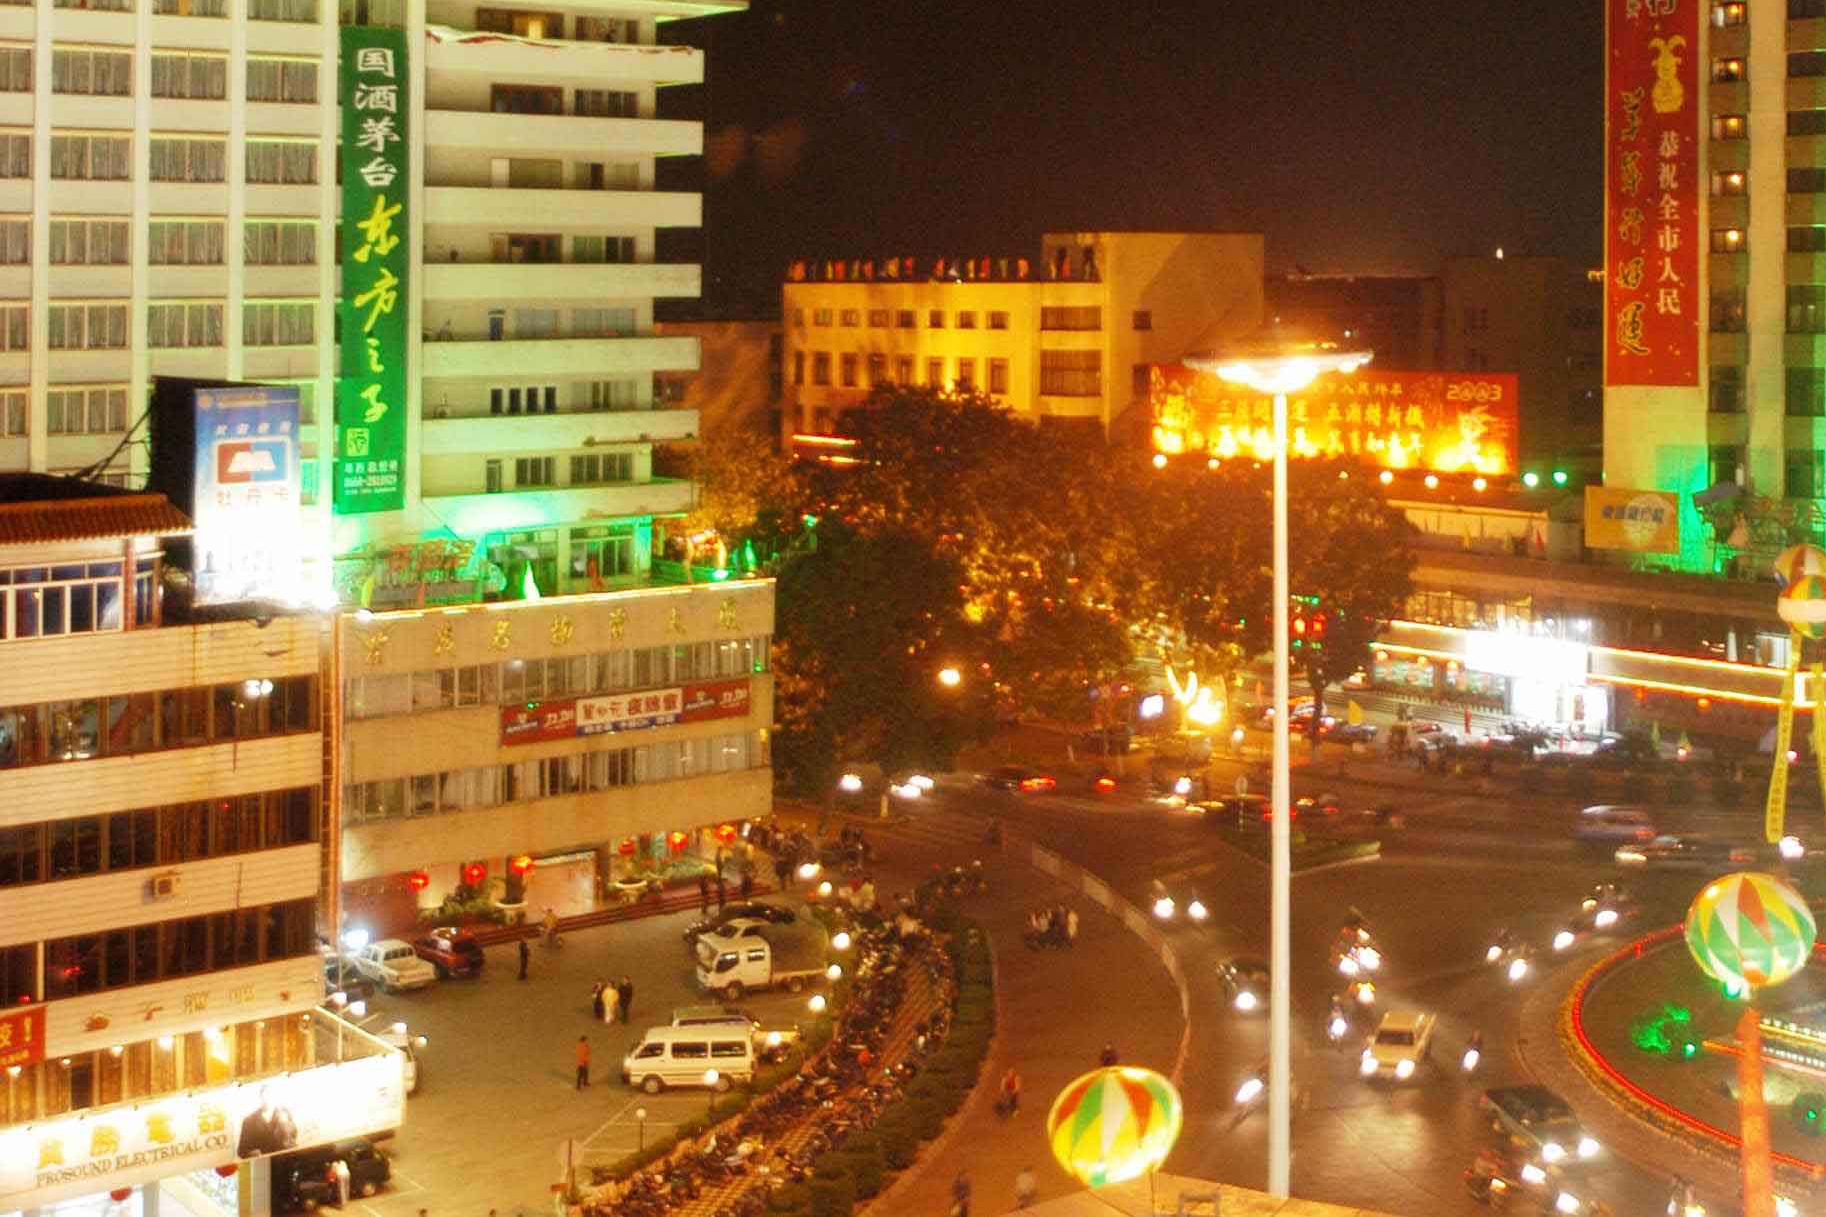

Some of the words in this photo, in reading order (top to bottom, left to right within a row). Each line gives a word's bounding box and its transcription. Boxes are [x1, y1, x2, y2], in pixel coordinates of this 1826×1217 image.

[353, 47, 402, 188] 国酒茅台
[1657, 130, 1681, 315] 恭祝全市人民
[1447, 383, 1502, 401] 2003
[36, 1158, 112, 1187] PROSOUND
[116, 1140, 202, 1170] ELECTRICAL
